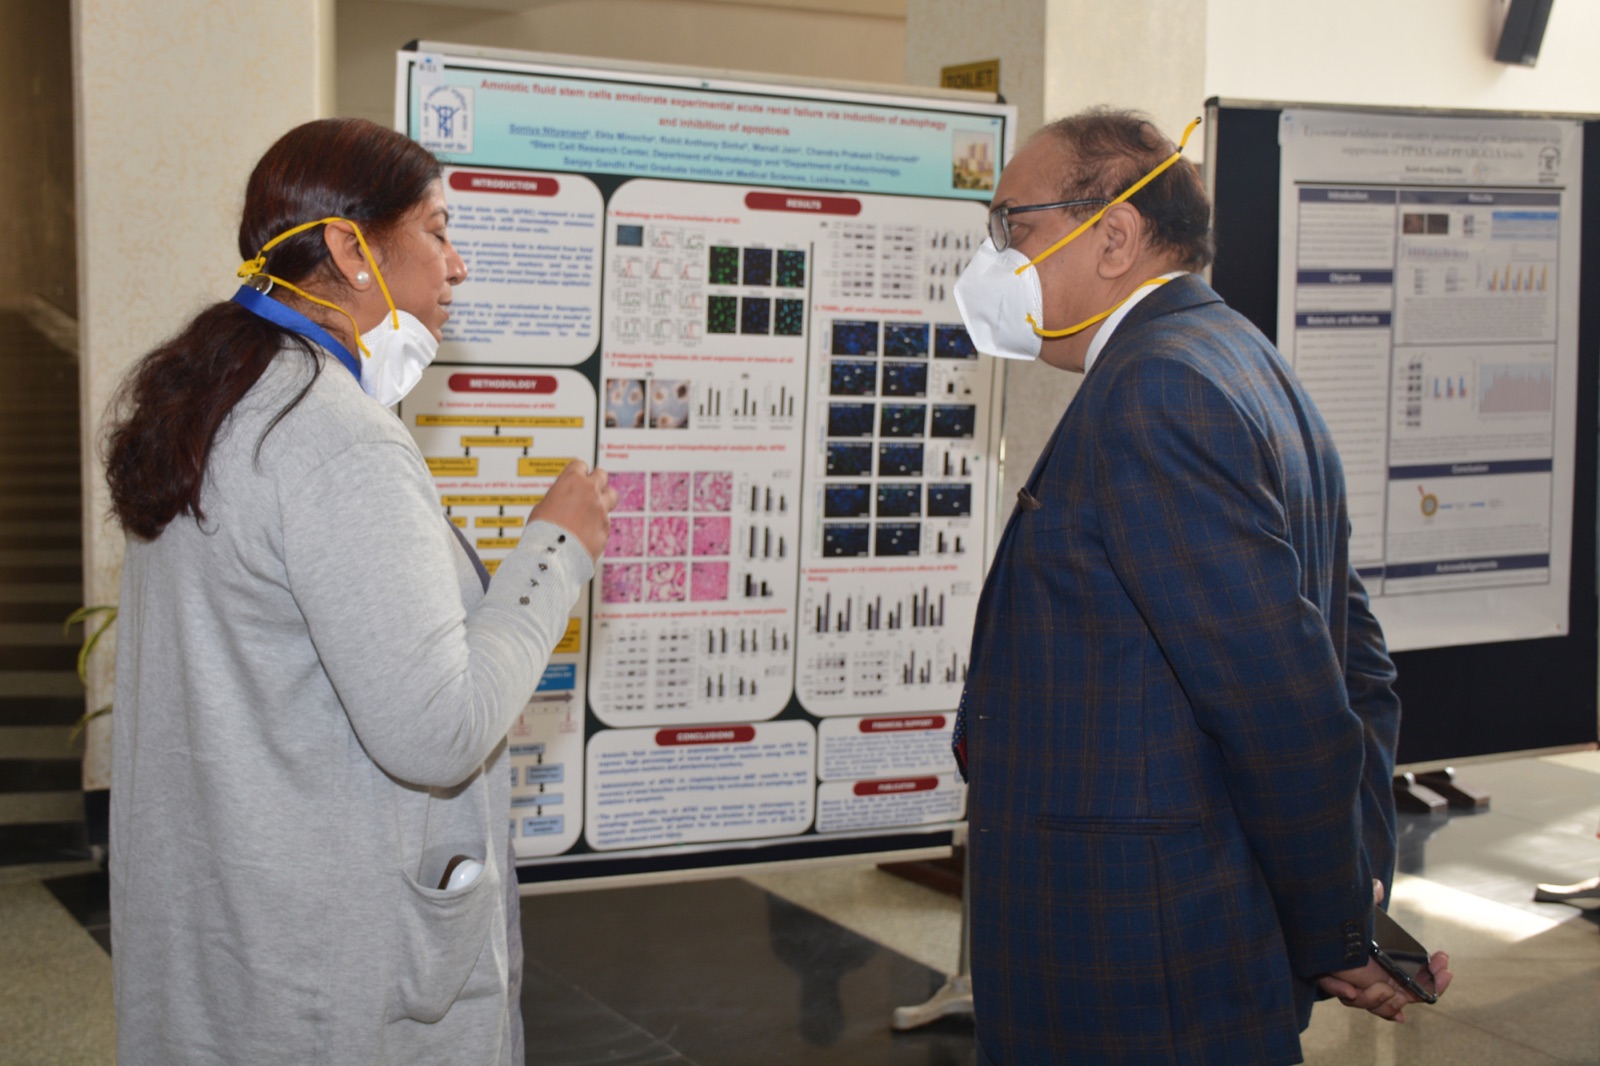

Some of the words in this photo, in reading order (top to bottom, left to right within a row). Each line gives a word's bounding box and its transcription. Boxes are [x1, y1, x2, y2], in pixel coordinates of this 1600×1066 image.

[946, 69, 993, 89] TOILET
[481, 79, 529, 93] Amniotic
[533, 83, 556, 95] fluid
[560, 85, 585, 97] stem
[588, 88, 612, 100] cells
[616, 90, 668, 104] ameliorate
[670, 95, 734, 112] experimental
[737, 100, 763, 112] acute
[766, 103, 791, 115] renal
[793, 105, 825, 118] failure
[827, 108, 840, 119] via
[843, 109, 886, 123] induction
[888, 113, 898, 124] of
[900, 114, 948, 130] autophagy
[659, 116, 678, 127] and
[680, 118, 726, 131] inhibition
[729, 121, 739, 132] of
[742, 122, 790, 138] apoptosis
[559, 140, 574, 151] Cell
[578, 142, 618, 155] Research
[653, 147, 700, 163] Department
[703, 151, 712, 162] of
[713, 152, 762, 168] Hematology
[765, 156, 780, 167] and
[834, 161, 843, 171] of
[563, 155, 593, 169] Sanjay
[595, 157, 625, 169] Gandhi
[629, 160, 648, 171] Post
[650, 161, 687, 174] Graduate
[690, 164, 722, 176] Institute
[725, 167, 734, 177] of
[737, 168, 767, 180] Medical
[471, 178, 538, 190] INTRODUCTION
[1327, 190, 1369, 200] Introduction
[1467, 193, 1493, 203] Results
[786, 199, 821, 210] RESULTS
[1329, 273, 1361, 284] Objective
[1306, 315, 1337, 325] Materials
[1338, 315, 1350, 325] and
[1351, 315, 1379, 325] Methods
[469, 379, 537, 390] METHODOLOGY
[676, 731, 735, 742] CONCLUSIONS
